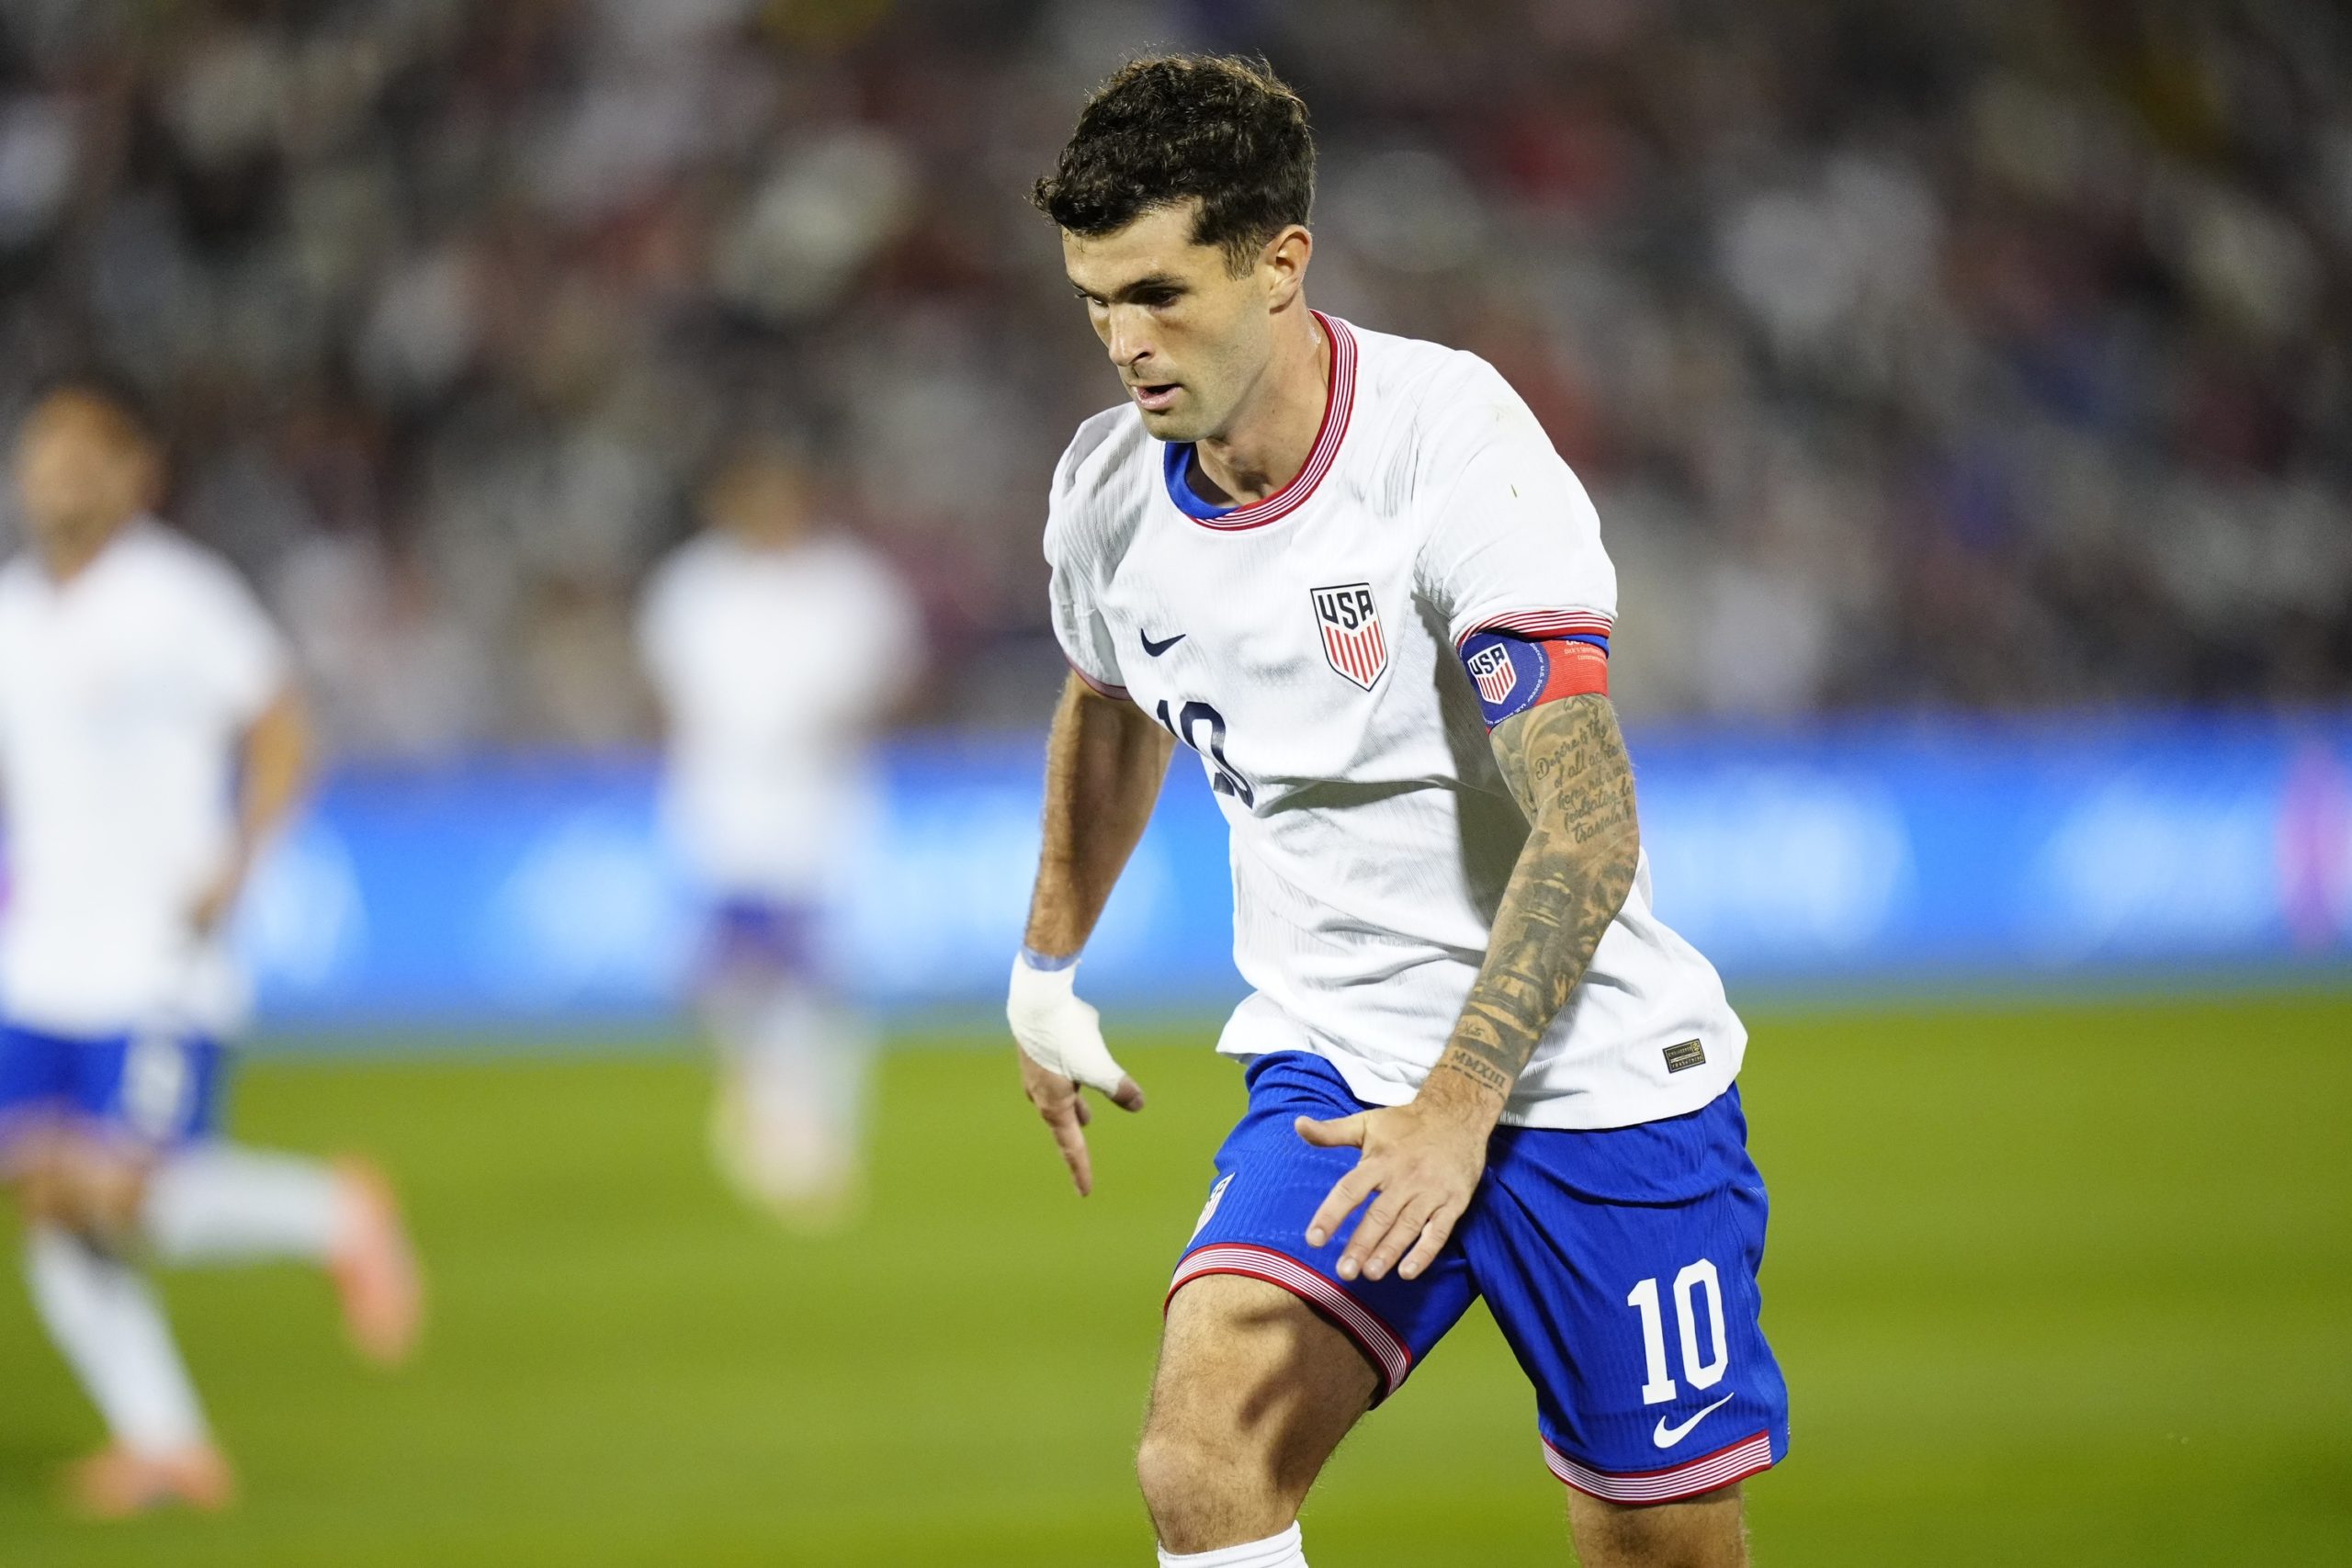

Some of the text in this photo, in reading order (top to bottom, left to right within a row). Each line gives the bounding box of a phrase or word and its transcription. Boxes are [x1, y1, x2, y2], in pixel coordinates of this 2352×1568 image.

[1317, 590, 1374, 630] USA
[1469, 647, 1505, 675] USA
[1567, 749, 1587, 778] all
[1627, 1258, 1728, 1405] 10
